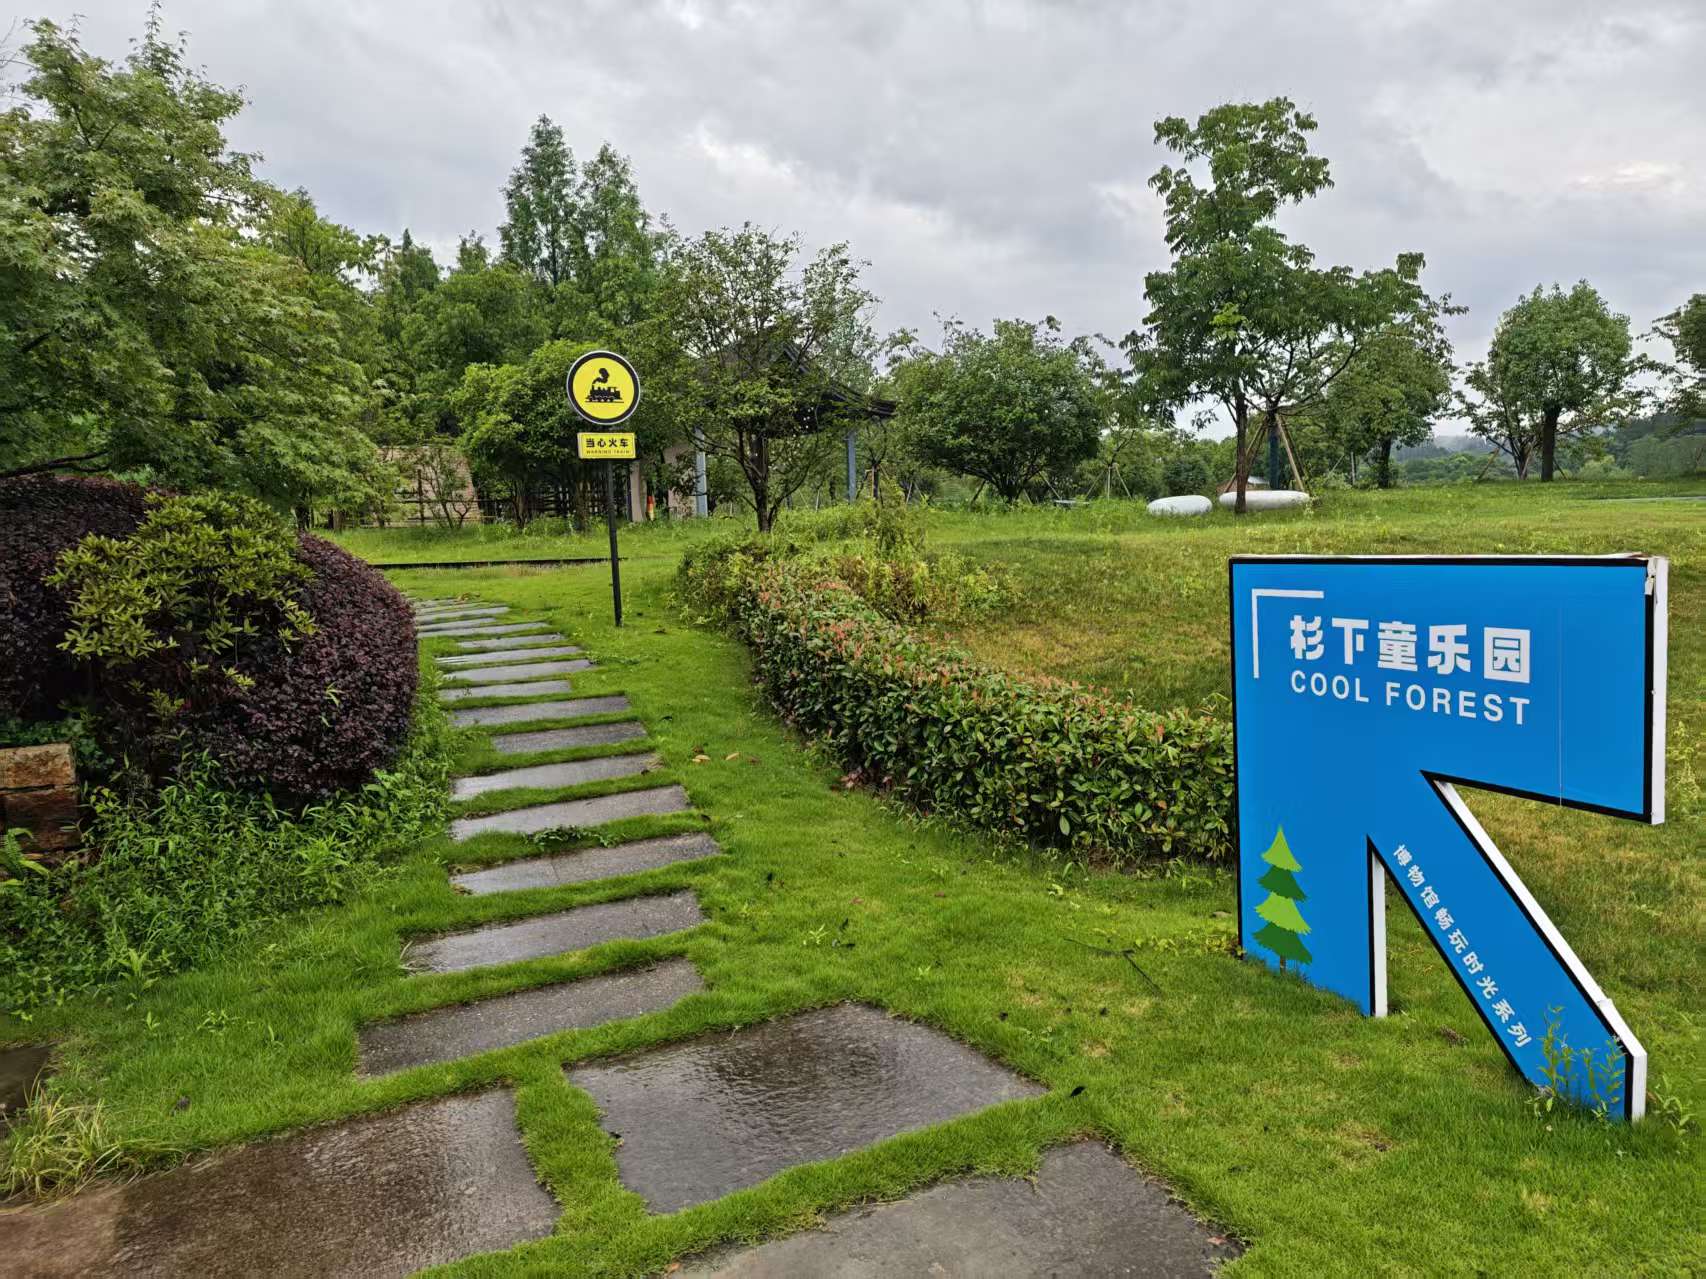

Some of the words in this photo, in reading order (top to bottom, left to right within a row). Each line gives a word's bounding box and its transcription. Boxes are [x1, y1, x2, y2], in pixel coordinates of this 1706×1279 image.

[586, 438, 629, 448] 当心火车
[1290, 614, 1531, 684] 杉下童乐园
[1290, 670, 1370, 704] COOL
[1385, 681, 1531, 725] FOREST
[1393, 844, 1533, 1048] 博物馆畅玩时光系列
